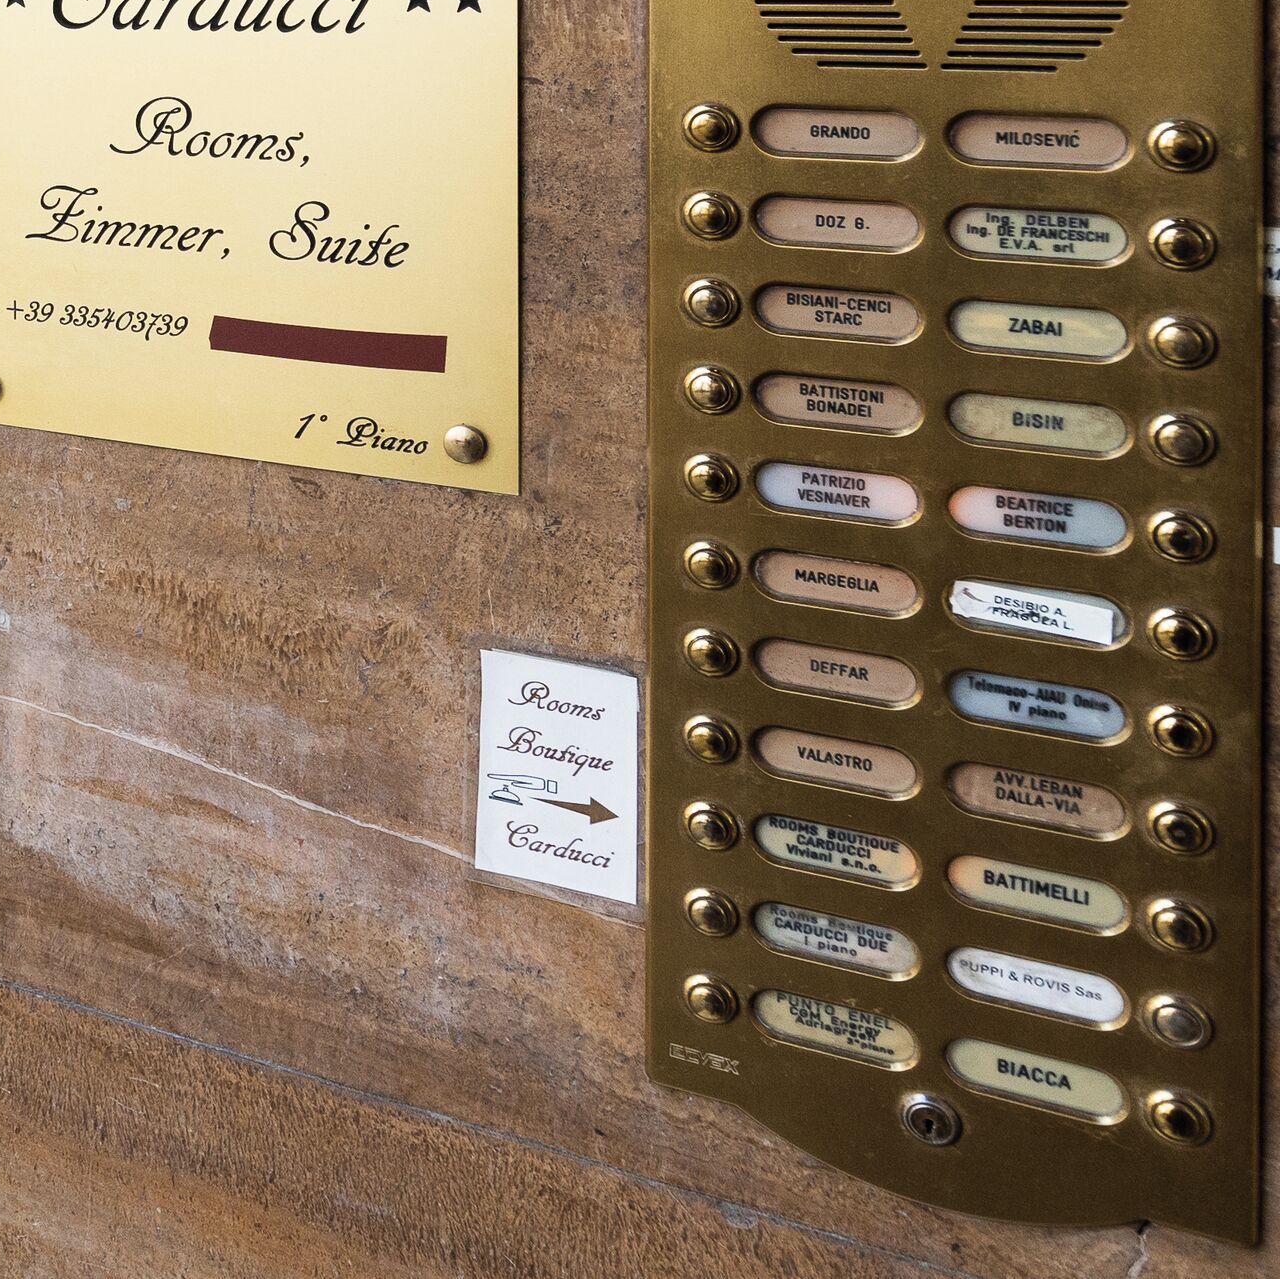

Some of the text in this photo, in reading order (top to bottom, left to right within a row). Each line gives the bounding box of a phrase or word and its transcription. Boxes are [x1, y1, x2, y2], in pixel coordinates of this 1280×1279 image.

[110, 96, 311, 167] Rooms,
[810, 125, 870, 140] GRANDO
[25, 185, 410, 268] Zimmer, Suite
[816, 215, 870, 230] DOZ G.
[1026, 214, 1089, 229] DELBEN
[998, 226, 1014, 237] DE
[1021, 227, 1110, 243] FRANCESCHI
[1053, 242, 1075, 253] srl
[787, 293, 891, 313] BISIANI-CENCI
[6, 300, 189, 341] +39 335403739
[815, 310, 862, 326] STARC
[1009, 318, 1062, 336] ZABAI
[800, 383, 883, 404] BATTISTONI
[807, 399, 872, 418] BONADEI
[294, 413, 429, 454] 1° Piano
[802, 472, 866, 491] PATRIZIO
[798, 488, 870, 508] VESNAVER
[996, 495, 1074, 517] BEATRICE
[1003, 514, 1066, 533] BERTON
[795, 569, 879, 592] MARGEGLIA
[810, 659, 869, 681] DEFFAR
[508, 681, 606, 721] Rooms
[497, 726, 614, 776] Boutique
[797, 746, 872, 772] VALASTRO
[996, 787, 1082, 815] DALLA-VIA
[506, 820, 615, 868] Carducci
[769, 816, 900, 853] ROOMS BOUTIQUE
[787, 843, 832, 863] Viviani
[797, 834, 871, 859] CARDUCCI
[984, 870, 1089, 906] BATTIMELLI
[770, 905, 818, 923] Rooms
[775, 918, 888, 952] CARDUCCI DUE
[818, 941, 857, 957] piano
[1009, 972, 1019, 982] &
[1024, 974, 1070, 993] ROVIS
[1075, 986, 1103, 1001] Sas
[849, 1009, 894, 1031] ENEL
[997, 1058, 1071, 1091] BIACCA
